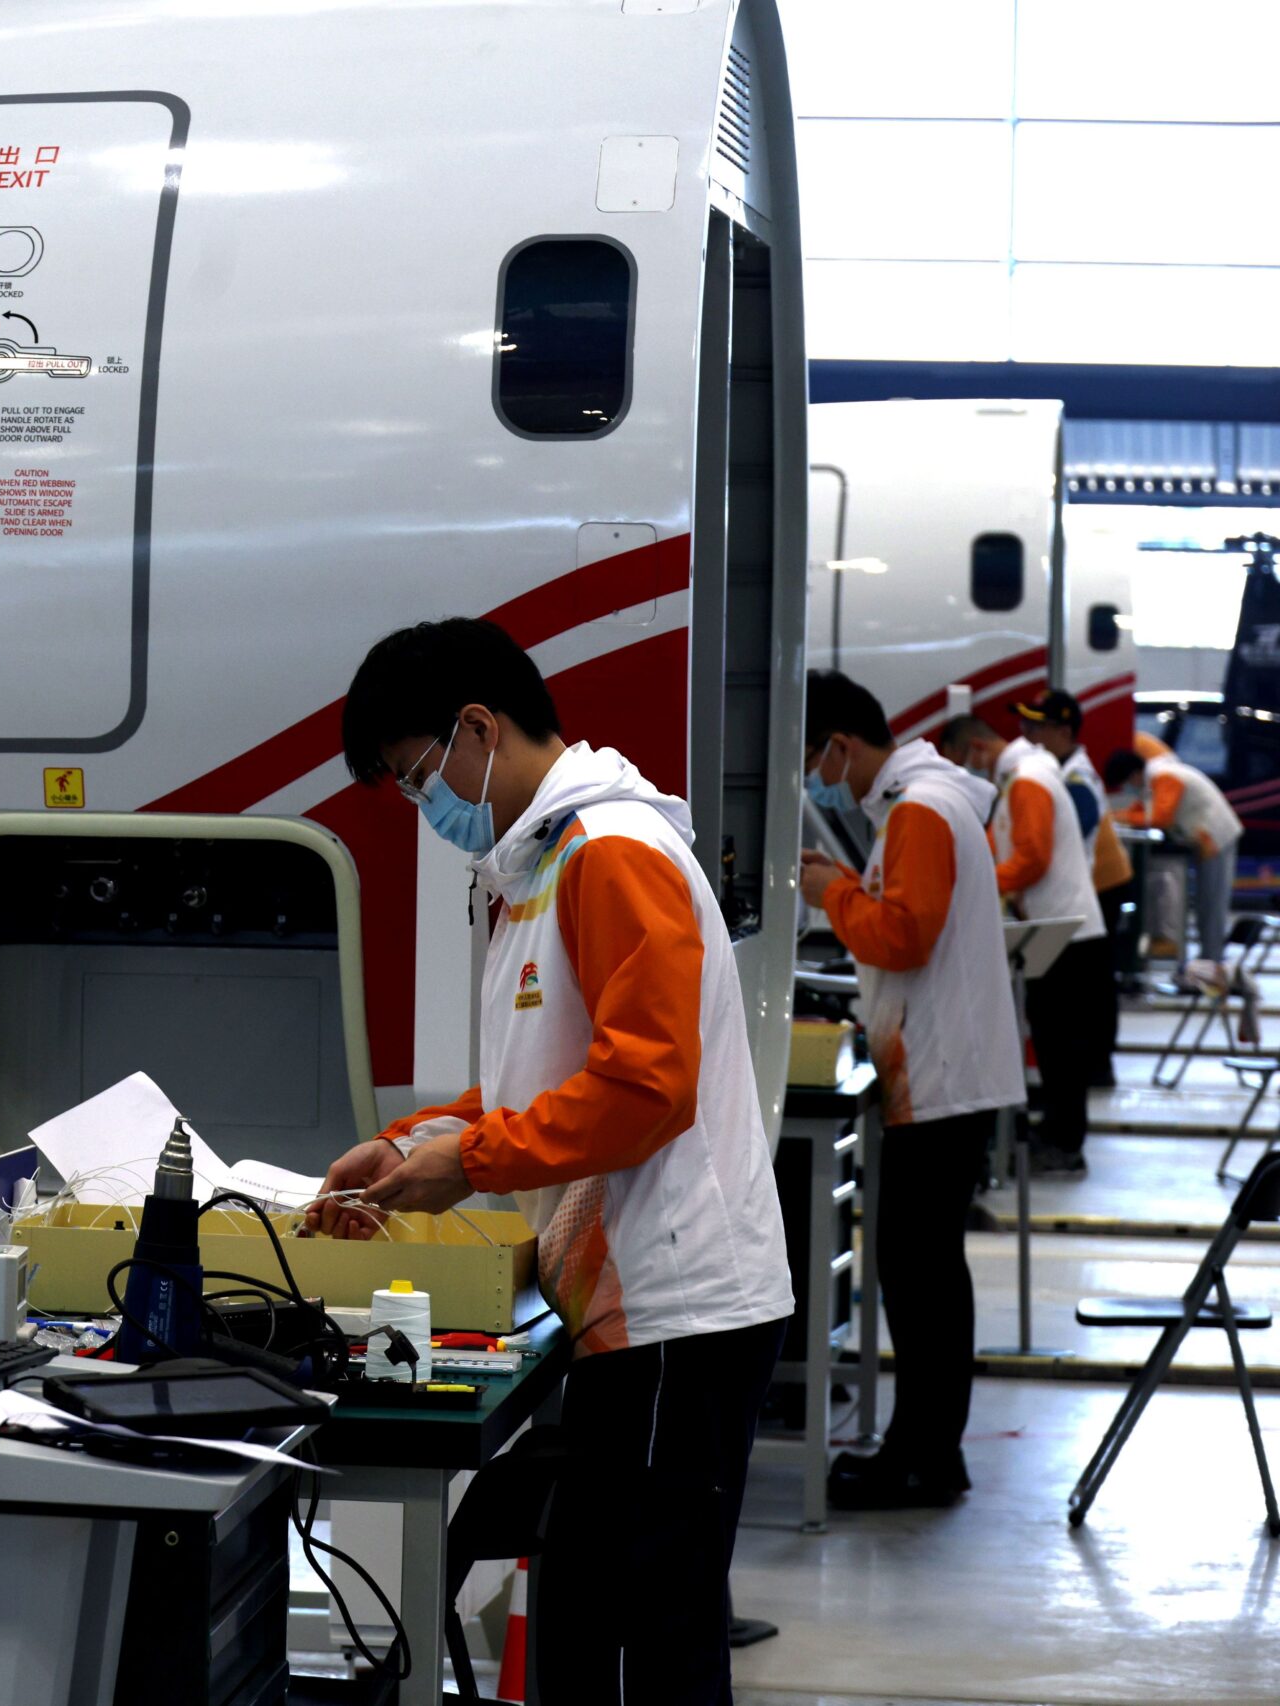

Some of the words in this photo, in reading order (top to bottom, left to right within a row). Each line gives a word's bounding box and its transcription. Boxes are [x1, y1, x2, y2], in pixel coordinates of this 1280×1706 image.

[98, 365, 129, 374] LOCKED
[2, 406, 20, 414] PULL
[54, 407, 85, 415] ENGAGE
[1, 416, 31, 424] HANDLE
[33, 416, 62, 424] ROTATE
[64, 416, 74, 424] AS
[15, 469, 49, 477] CAUTION
[39, 480, 76, 488] WEBBING
[28, 489, 37, 497] IN
[39, 489, 73, 497] WINDOW
[43, 499, 72, 507] ESCAPE
[22, 518, 46, 526] CLEAR
[48, 519, 72, 527] WHEN
[3, 528, 38, 536] OPENING
[40, 528, 63, 536] DOOR
